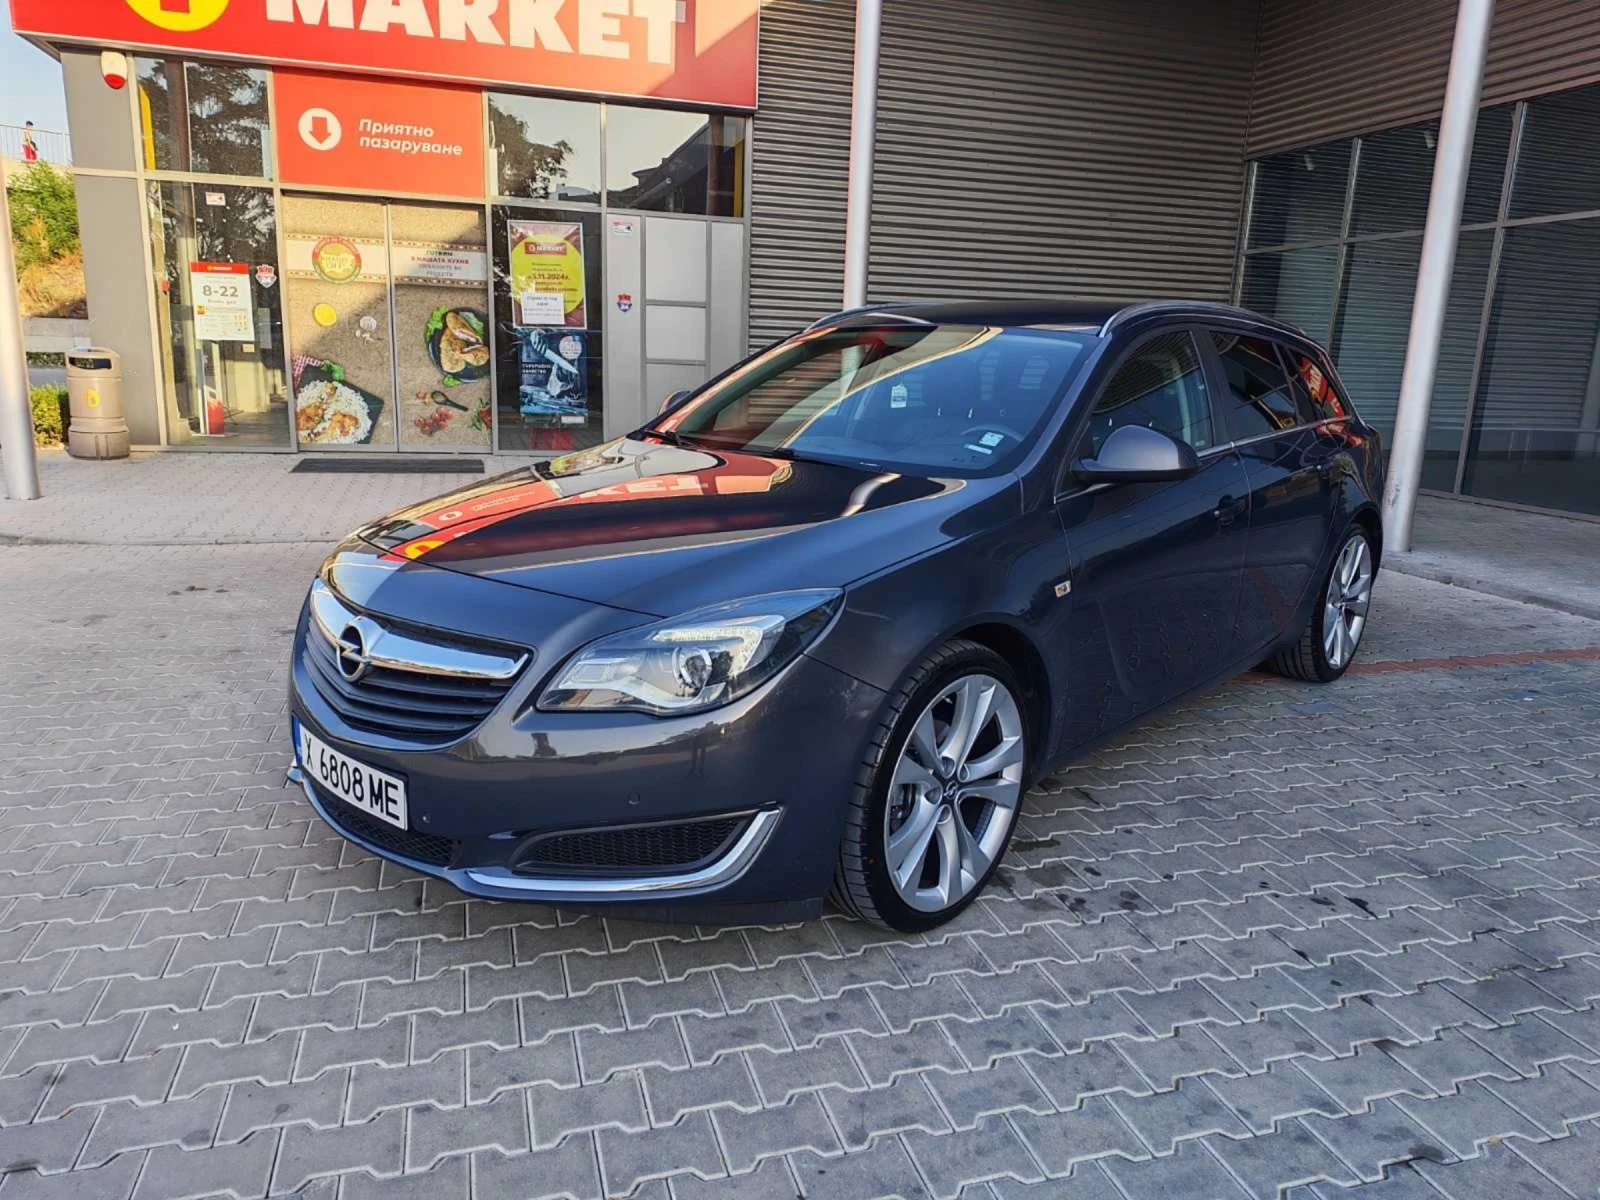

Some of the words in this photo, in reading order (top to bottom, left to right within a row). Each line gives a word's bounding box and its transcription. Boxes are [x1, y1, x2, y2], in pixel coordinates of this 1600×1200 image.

[358, 118, 434, 138] Приятно
[359, 136, 463, 156] пазаруване
[202, 284, 239, 298] 8-22
[304, 733, 313, 769] X
[320, 748, 364, 802] 6808
[369, 773, 400, 821] ME
